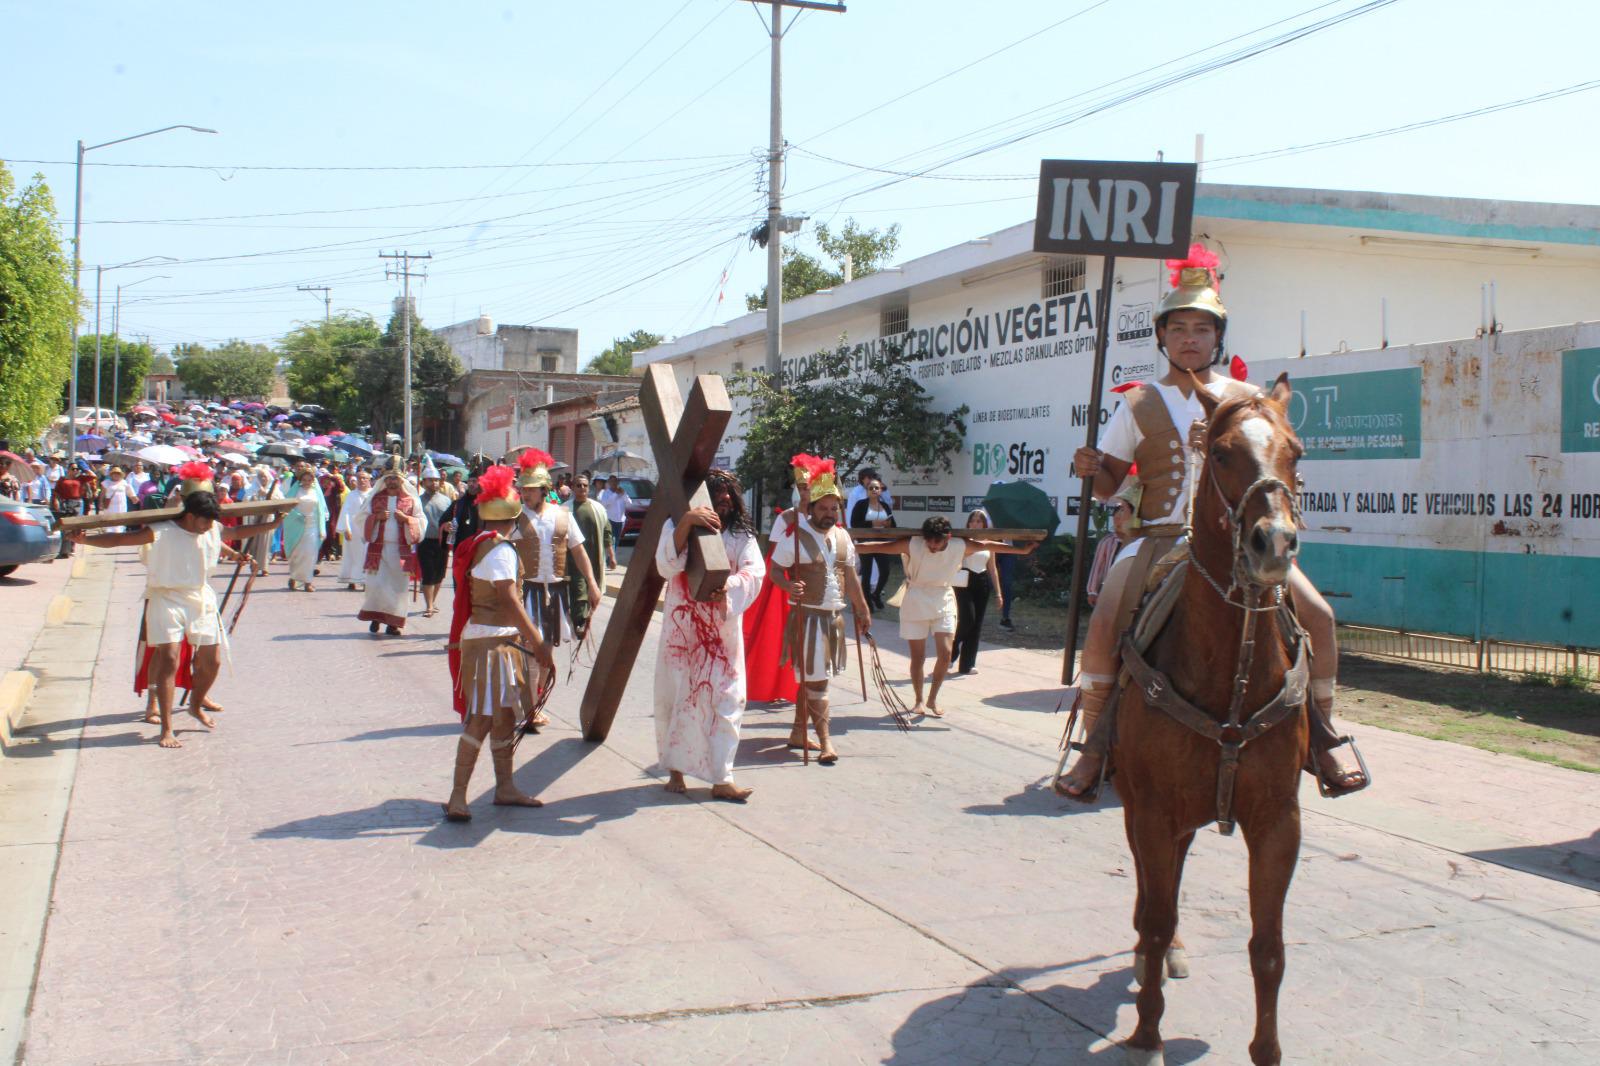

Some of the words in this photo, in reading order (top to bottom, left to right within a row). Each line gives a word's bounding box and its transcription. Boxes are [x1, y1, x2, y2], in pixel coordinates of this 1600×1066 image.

[1048, 178, 1180, 245] INRI
[950, 355, 982, 375] QUELATOS
[990, 348, 1023, 368] MEZCLAS
[1025, 339, 1073, 361] GRANULARES
[989, 408, 997, 422] DE
[998, 405, 1050, 421] BIOESTIMULANTES
[1335, 413, 1403, 430] SOLUCIONES
[1367, 433, 1405, 449] PESADA
[1343, 492, 1351, 512] Y
[1356, 492, 1396, 514] SALIDA
[1402, 493, 1418, 515] DE
[1503, 493, 1533, 517] LAS
[1542, 493, 1563, 518] 24
